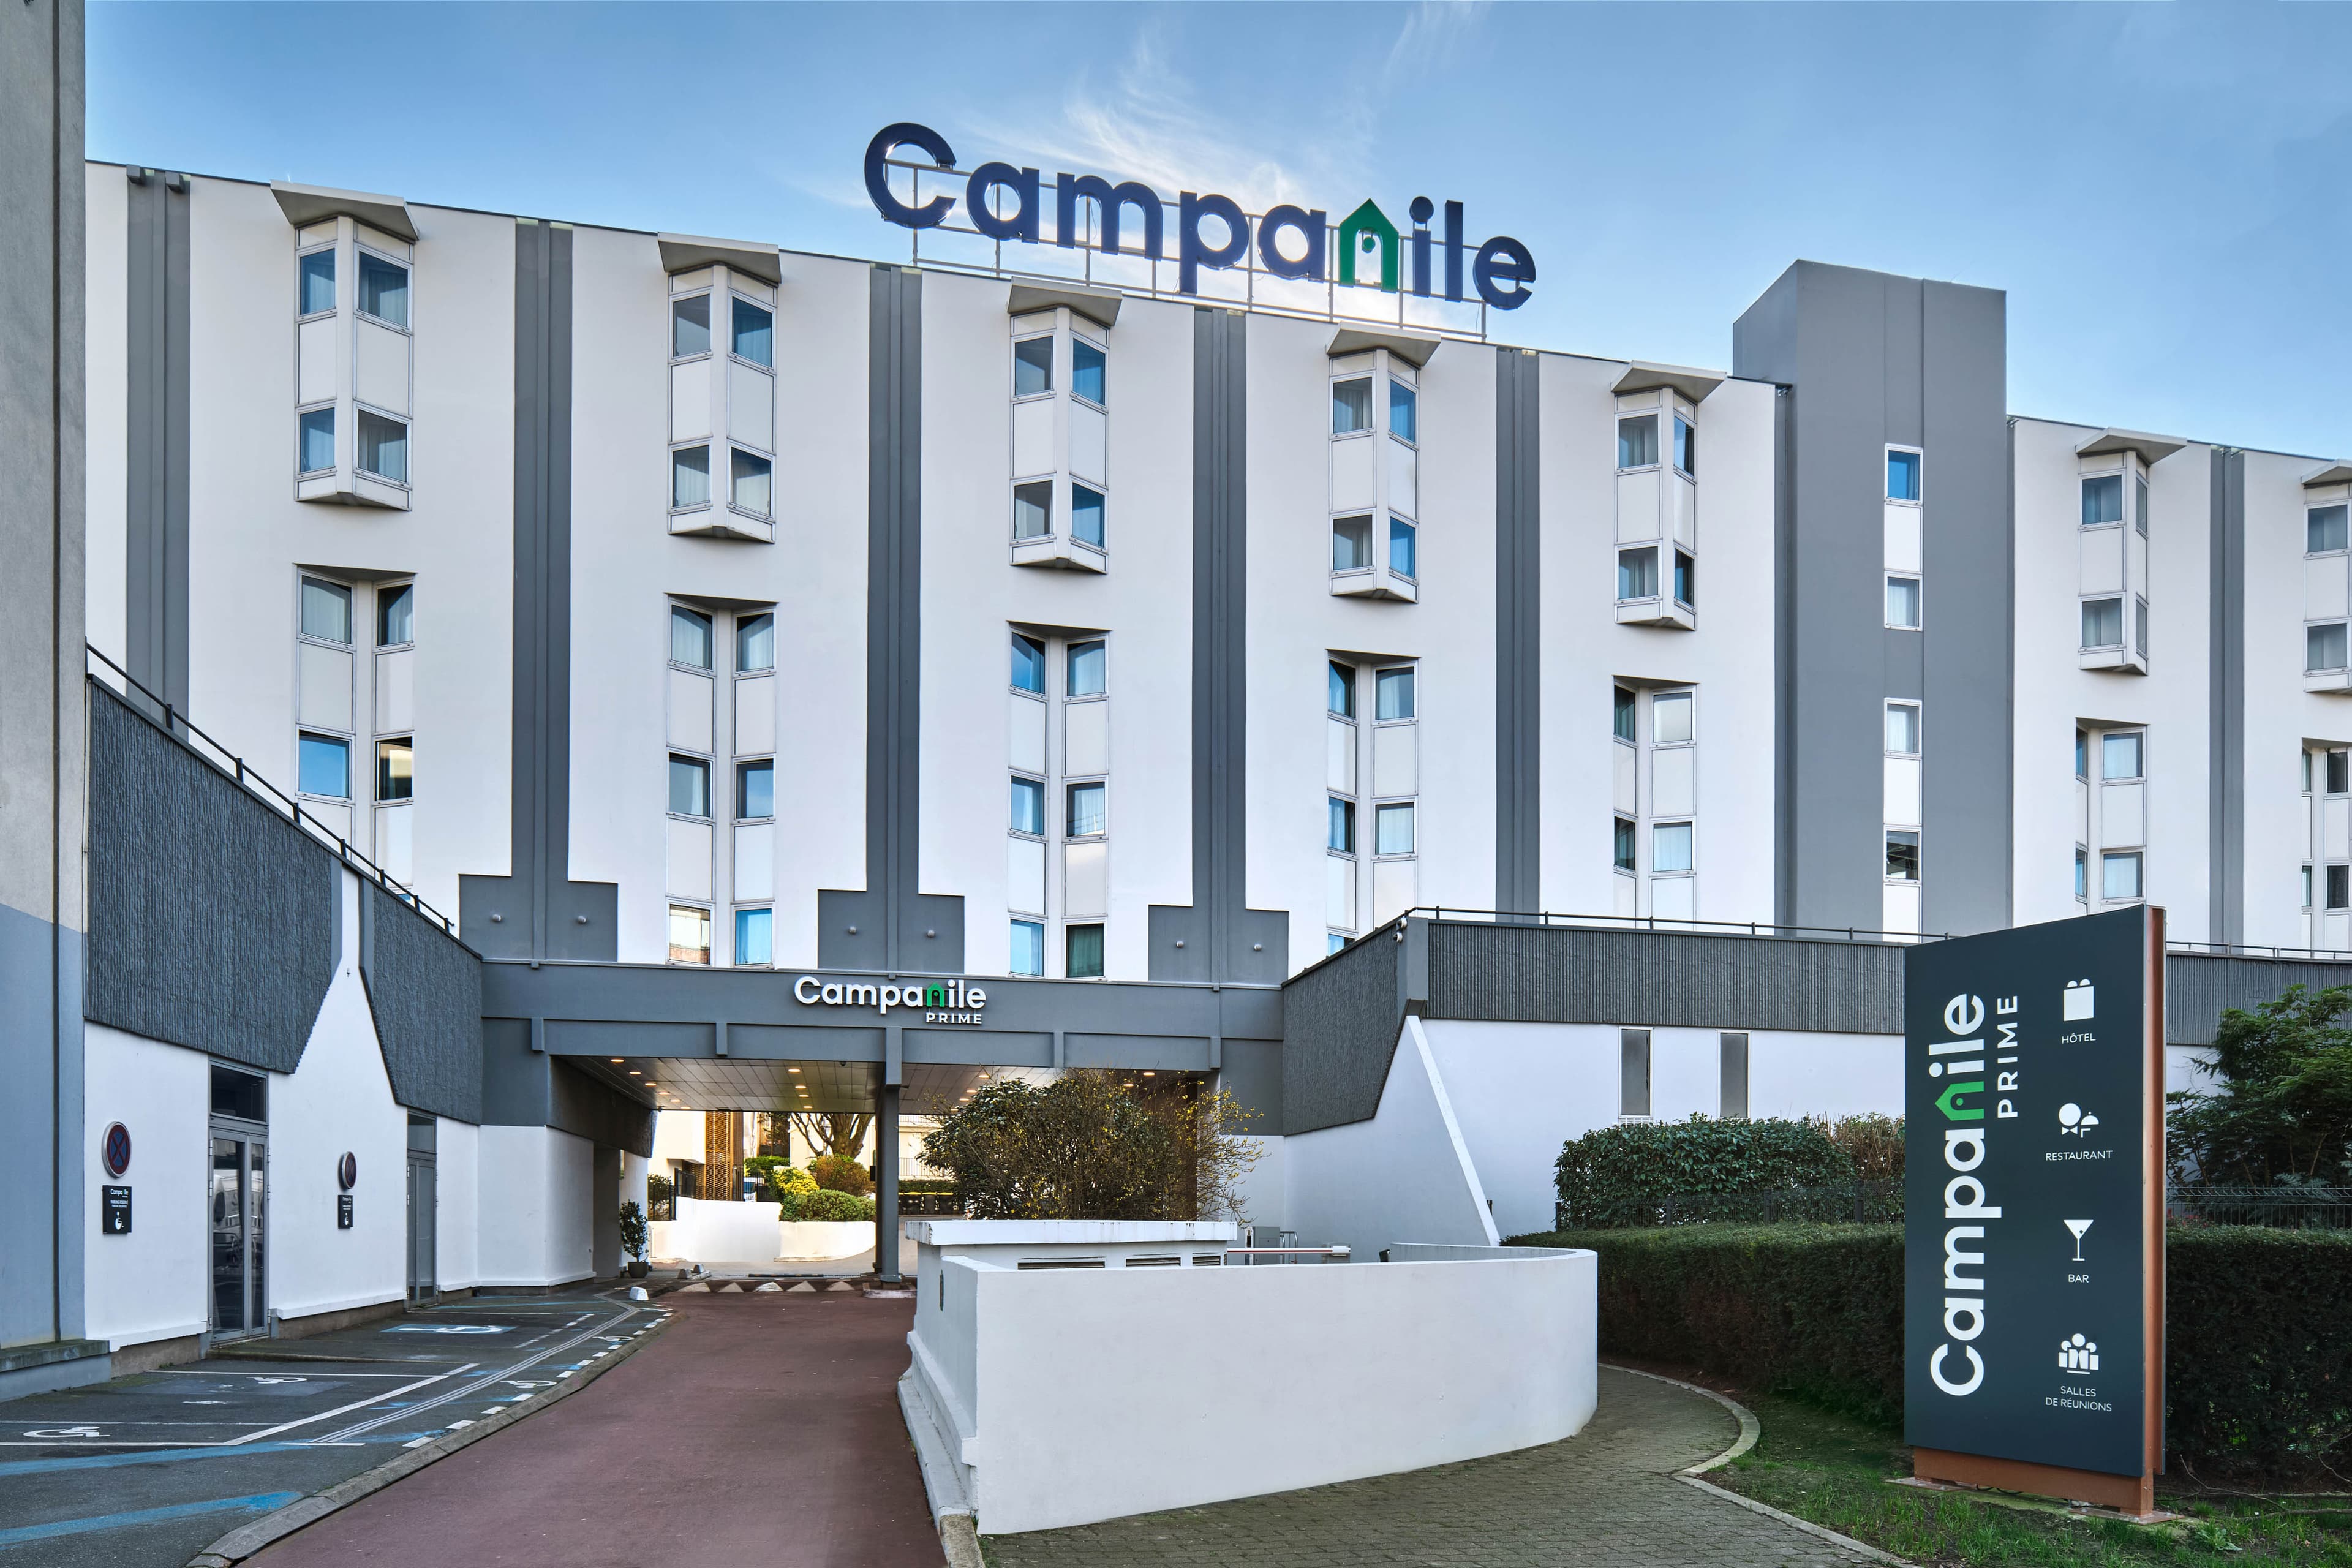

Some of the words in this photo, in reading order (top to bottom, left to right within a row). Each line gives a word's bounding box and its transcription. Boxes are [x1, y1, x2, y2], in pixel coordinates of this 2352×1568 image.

[864, 123, 1536, 310] Campanile
[794, 976, 986, 1014] Campanile
[925, 1012, 982, 1024] PRIME
[2062, 1033, 2096, 1044] HÔTEL
[1997, 995, 2018, 1118] PRIME
[2046, 1150, 2113, 1161] RESTAURANT
[1929, 993, 2002, 1396] Campanile
[2068, 1274, 2089, 1283] BAR
[2060, 1386, 2096, 1397] SALLES
[2045, 1397, 2058, 1406] DE
[2060, 1398, 2112, 1412] RÉUNIONS
